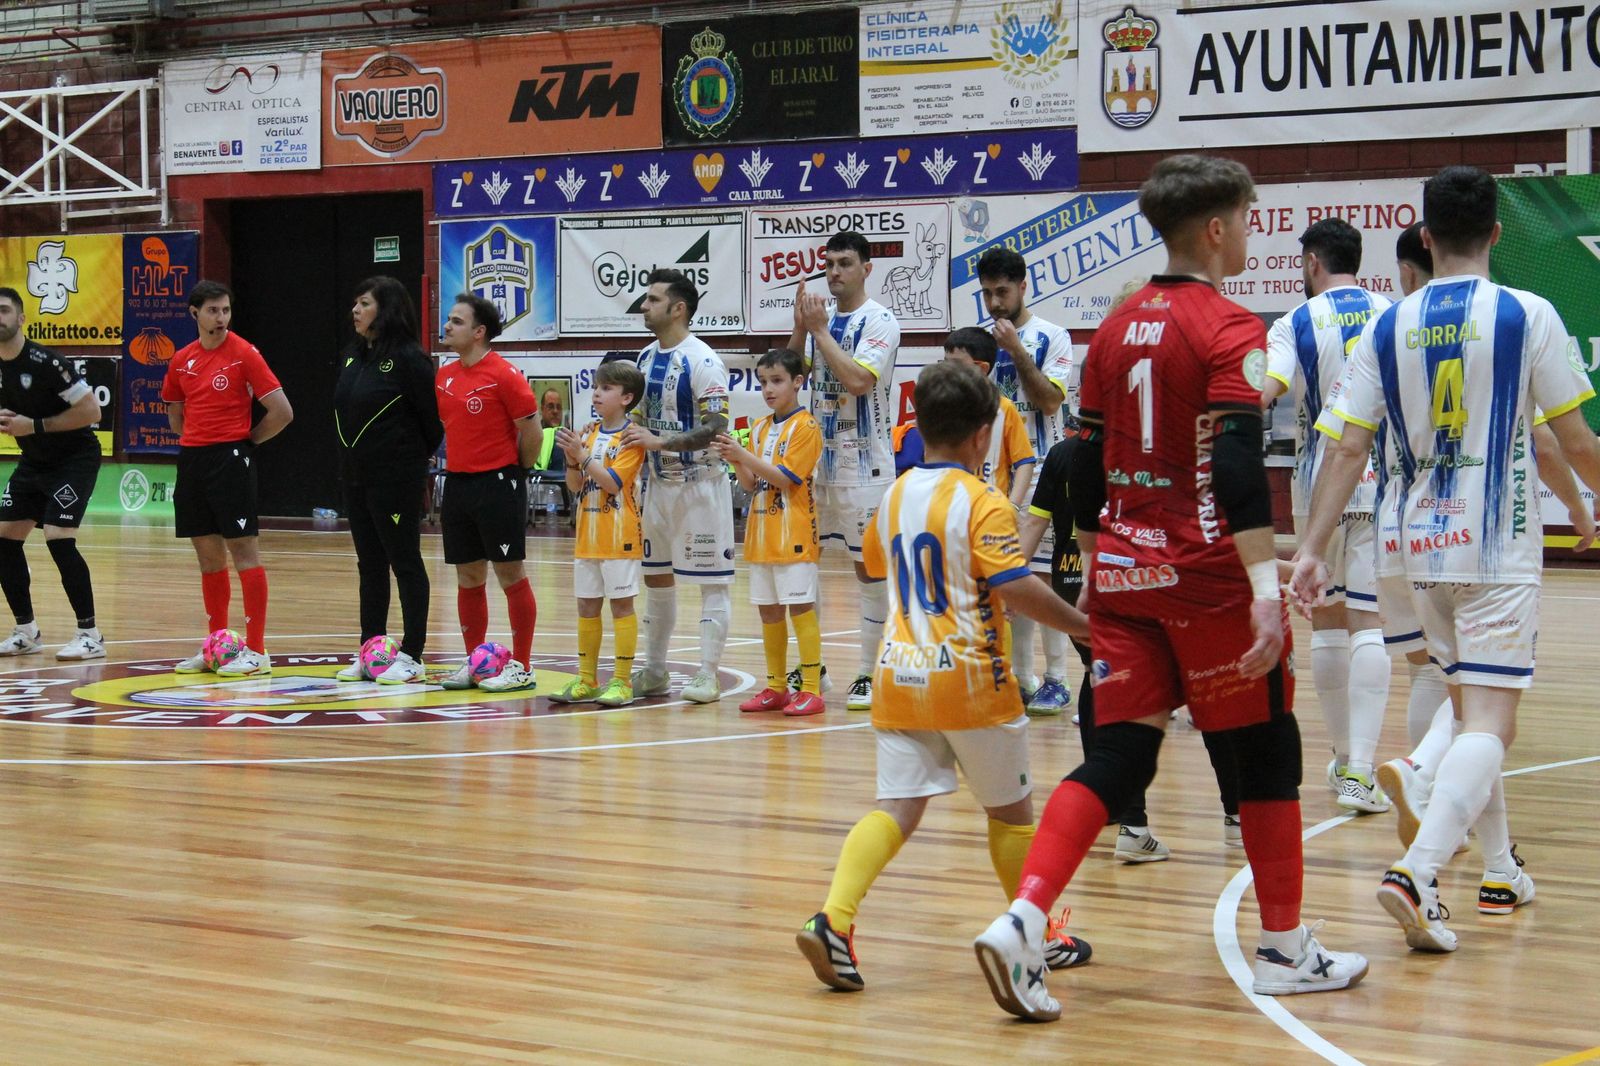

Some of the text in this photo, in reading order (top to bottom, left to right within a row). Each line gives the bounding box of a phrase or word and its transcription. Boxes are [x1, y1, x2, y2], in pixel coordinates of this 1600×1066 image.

[866, 10, 928, 26] CLÍNICA
[868, 24, 980, 42] FISIOTERAPIA
[752, 36, 854, 58] CLUB DE TIRO
[868, 42, 949, 58] INTEGRAL
[771, 65, 838, 86] EL JARAL
[508, 62, 640, 122] KTM
[185, 98, 301, 113] CENTRAL OPTICA
[339, 85, 439, 122] VAQUERO
[258, 116, 308, 126] ESPECIALISTAS
[174, 149, 216, 159] BENAVENTE
[260, 145, 273, 153] TU
[290, 143, 307, 151] PAR
[274, 156, 308, 164] REGALO
[695, 164, 723, 178] AMOR
[973, 152, 987, 184] Z
[799, 161, 813, 191] Z
[884, 156, 898, 188] Z
[452, 178, 463, 208] Z
[523, 175, 536, 205] Z
[600, 171, 612, 201] Z
[729, 189, 784, 201] CAJA RURAL
[758, 212, 905, 234] TRANSPORTES
[1248, 208, 1293, 234] AJE
[965, 197, 1099, 278] FRETERIA
[146, 248, 166, 257] Grupo
[1027, 211, 1163, 299] FUENT
[1266, 256, 1302, 270] OFIC
[132, 266, 188, 296] HLT
[496, 263, 528, 277] BENAVENTE
[598, 263, 709, 293] Gejons
[1220, 280, 1255, 295] AULT
[1262, 279, 1305, 293] TRUC
[1062, 296, 1111, 308] Tel. 980
[697, 316, 717, 326] 416
[721, 315, 740, 325] 289
[1314, 309, 1376, 330] V.MONT
[1122, 321, 1166, 345] ADRI
[1406, 320, 1482, 350] CORRAL
[1128, 358, 1152, 453] 1
[1431, 357, 1469, 442] 4
[1417, 498, 1466, 508] LOS VALLES
[1410, 528, 1472, 556] MACIAS
[891, 532, 949, 617] 10
[1097, 564, 1178, 592] MACIAS
[881, 642, 953, 669] ZAMORA
[896, 673, 925, 685] ENAMORA
